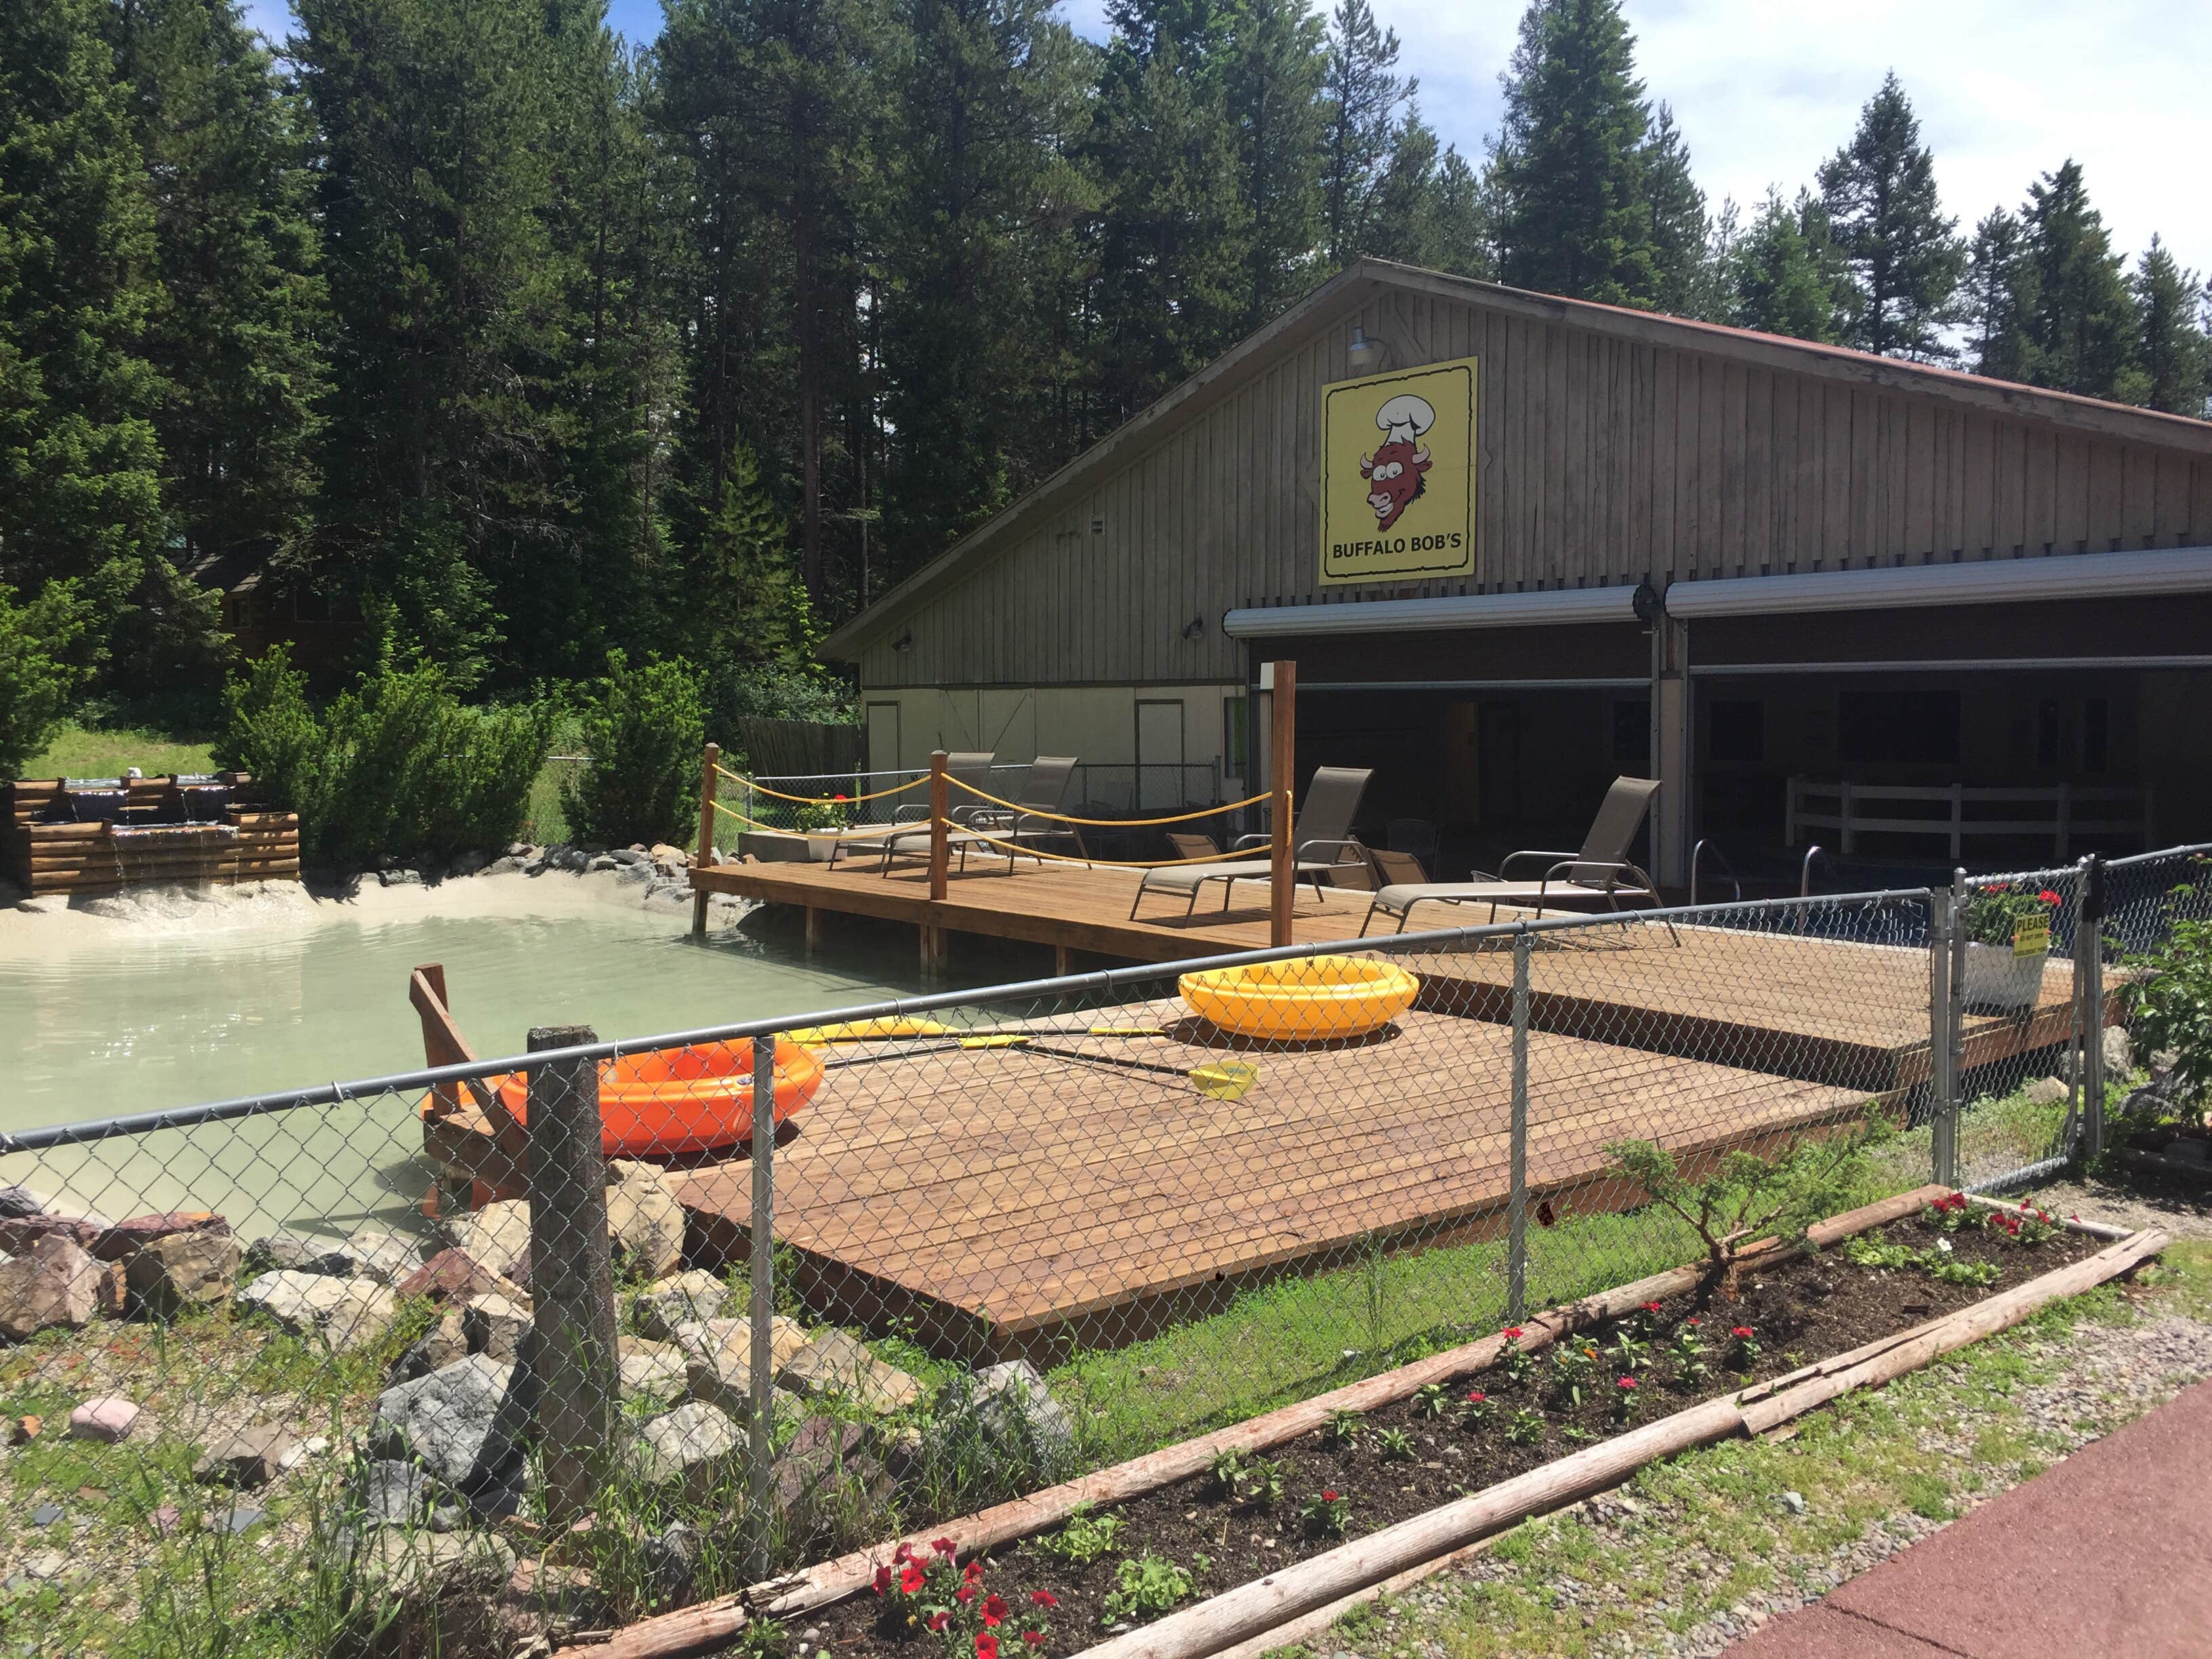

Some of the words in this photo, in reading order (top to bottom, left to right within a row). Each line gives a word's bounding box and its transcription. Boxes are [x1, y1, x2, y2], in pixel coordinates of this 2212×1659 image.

[1333, 538, 1406, 558] BUFFALO
[1411, 533, 1461, 552] BOB'S
[2017, 916, 2049, 933] PLEASE
